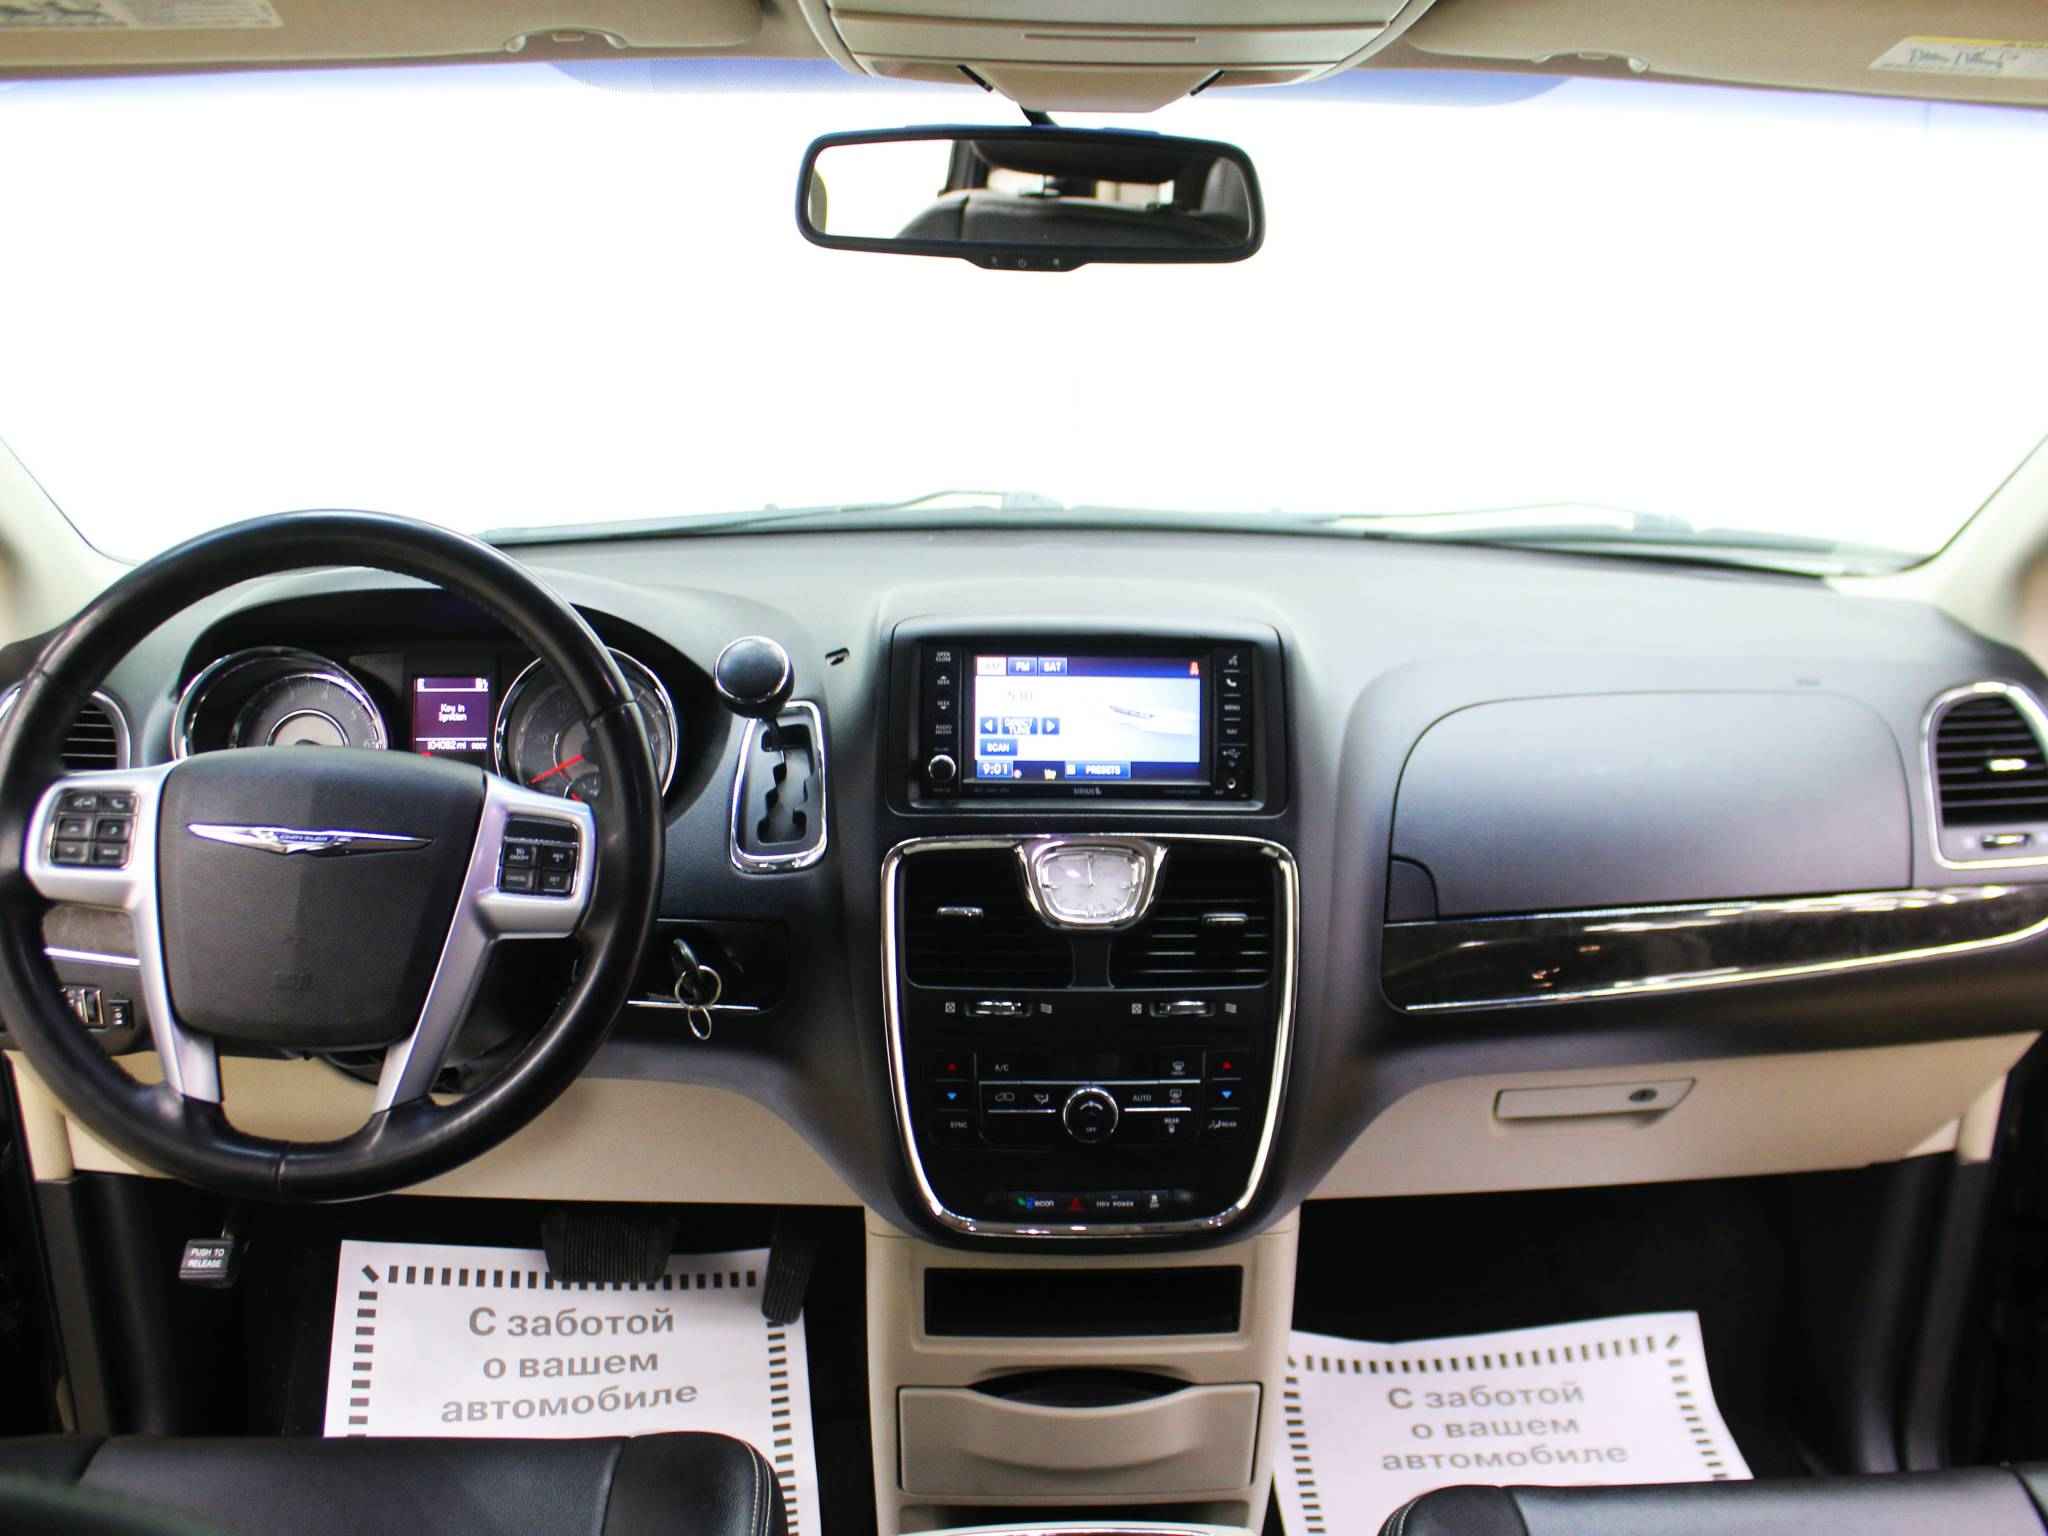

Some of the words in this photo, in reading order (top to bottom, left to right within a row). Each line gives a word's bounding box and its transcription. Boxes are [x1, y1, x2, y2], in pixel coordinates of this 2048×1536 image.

[1043, 661, 1062, 673] SAT
[983, 763, 1008, 776] 9:01
[994, 1064, 1009, 1072] A/C
[1132, 1094, 1152, 1102] AUTO
[469, 1306, 497, 1337] С
[507, 1306, 675, 1337] заботой
[482, 1357, 507, 1380] о
[519, 1353, 659, 1379] вашем
[440, 1384, 699, 1424] автомобиле
[1387, 1387, 1414, 1410] С
[1424, 1381, 1586, 1410] заботой
[1411, 1423, 1433, 1440] о
[1444, 1417, 1581, 1440] вашем
[1382, 1442, 1629, 1471] автомобиле
